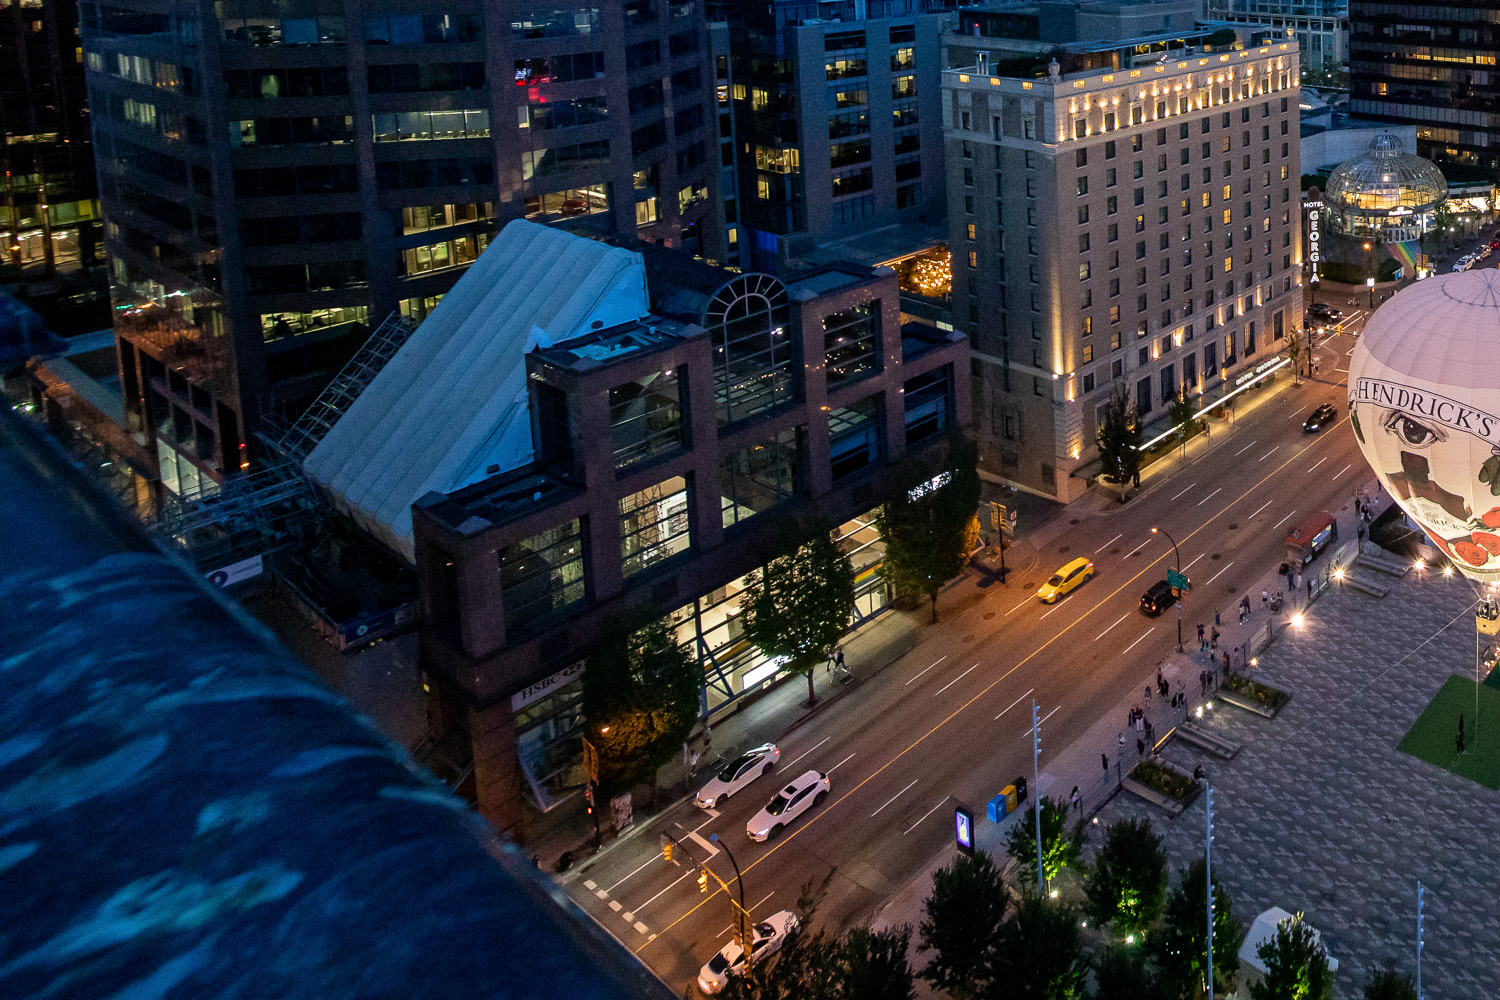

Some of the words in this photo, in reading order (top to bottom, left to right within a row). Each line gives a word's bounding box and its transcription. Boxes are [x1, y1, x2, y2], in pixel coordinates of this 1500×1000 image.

[1309, 210, 1320, 283] GEORGIA
[1358, 380, 1495, 437] HENDRICK'S
[522, 674, 560, 699] HSBC
